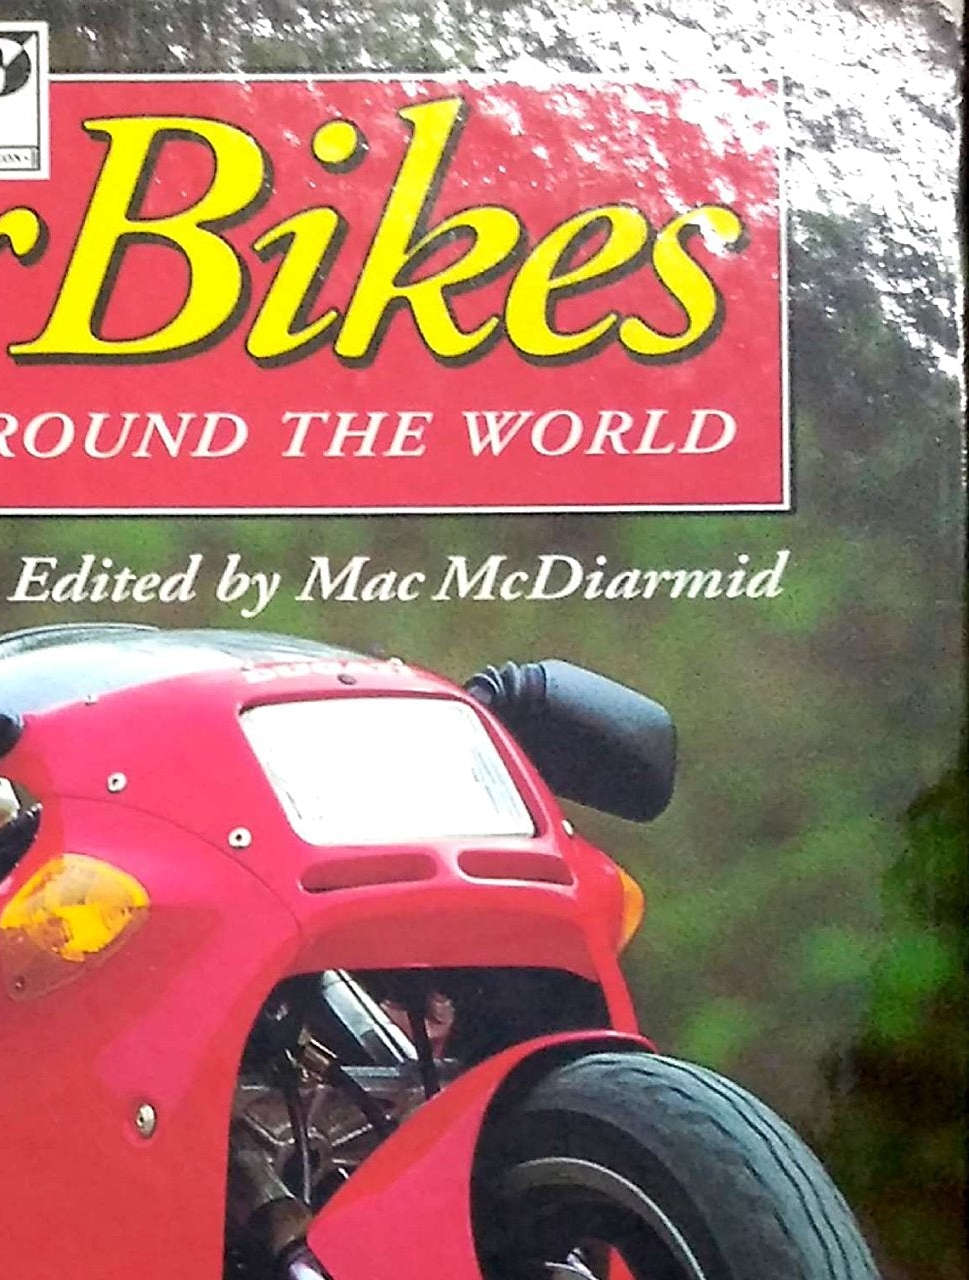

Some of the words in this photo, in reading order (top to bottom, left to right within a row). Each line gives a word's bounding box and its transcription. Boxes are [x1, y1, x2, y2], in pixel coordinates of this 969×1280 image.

[282, 411, 433, 457] THE
[463, 409, 737, 456] WORLD
[6, 553, 203, 603] Edited
[216, 553, 282, 618] by
[295, 556, 427, 602] Mac
[431, 549, 791, 601] McDiarmid
